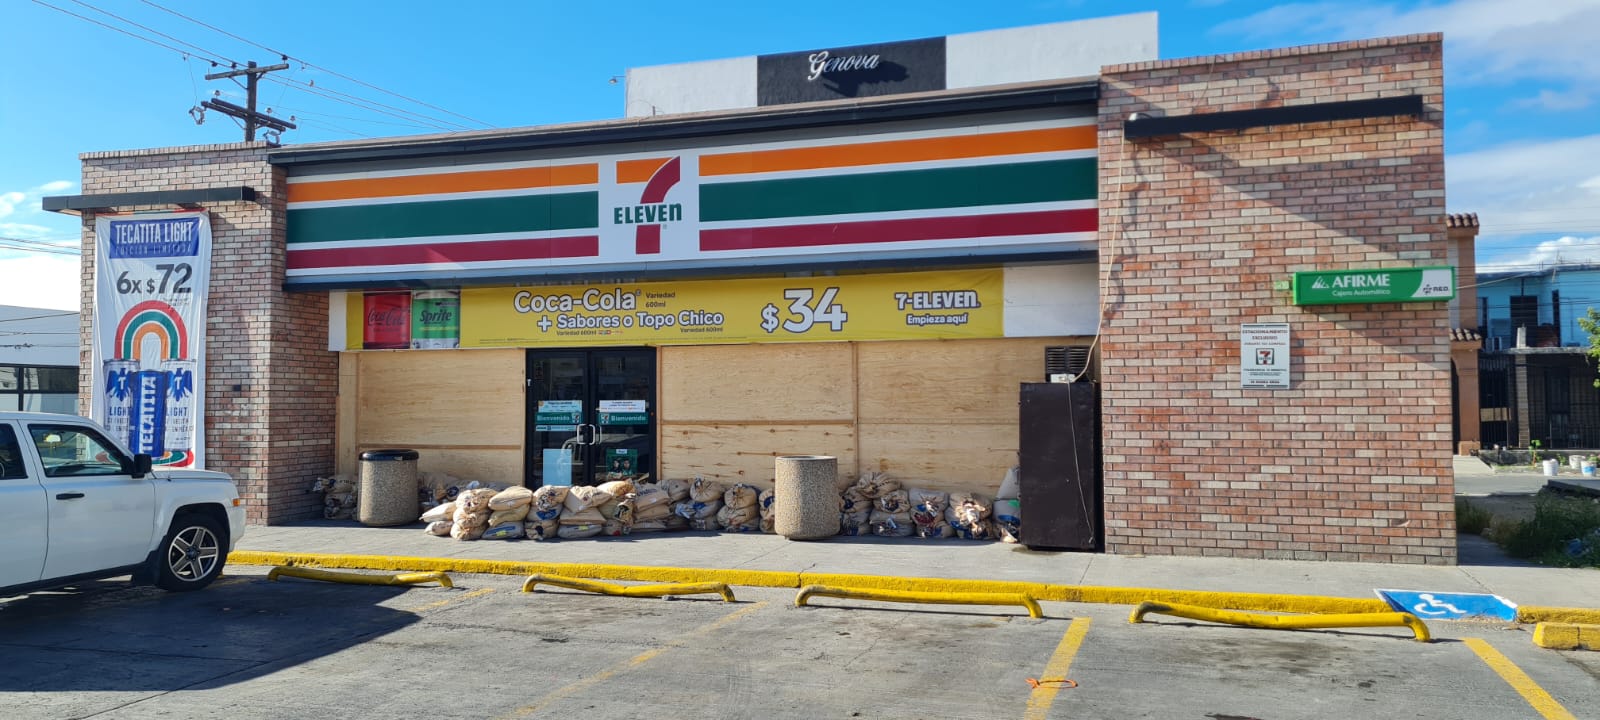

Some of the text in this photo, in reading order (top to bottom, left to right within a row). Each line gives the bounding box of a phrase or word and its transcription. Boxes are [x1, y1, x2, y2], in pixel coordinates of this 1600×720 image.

[808, 51, 880, 80] Genova
[616, 154, 681, 254] 7
[115, 221, 194, 245] TECATITA LIGHT
[116, 271, 142, 295] 6x
[1332, 274, 1390, 288] AFIRME
[514, 288, 636, 313] Coca-Cola
[645, 291, 676, 299] Variedad
[420, 308, 452, 323] Sprite
[556, 313, 620, 329] Sabores
[622, 316, 633, 328] o
[636, 311, 675, 328] Topo
[677, 310, 724, 326] Chico
[906, 312, 969, 326] Empieza aquí
